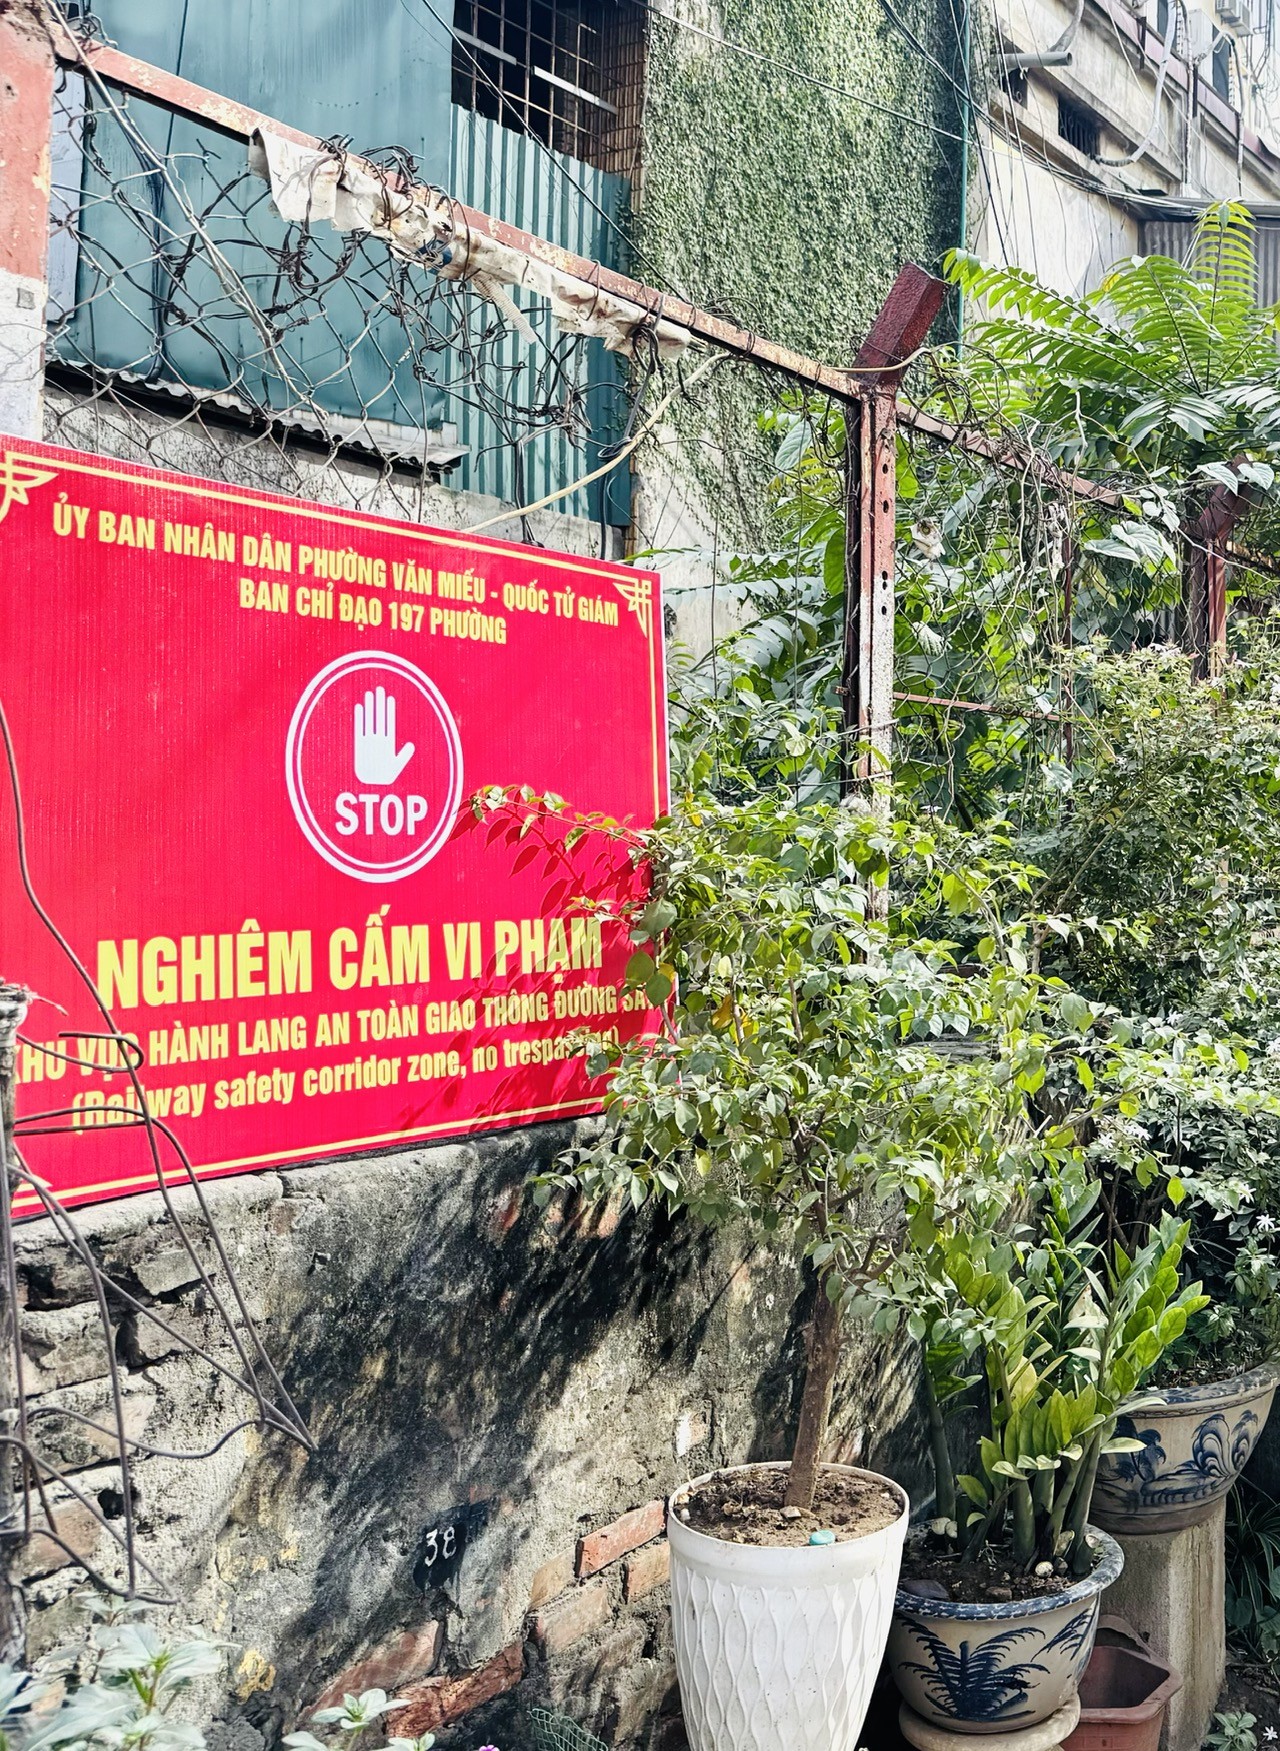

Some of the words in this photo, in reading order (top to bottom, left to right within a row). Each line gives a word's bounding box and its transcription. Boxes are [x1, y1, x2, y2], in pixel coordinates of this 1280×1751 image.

[53, 492, 90, 539] ỦY
[98, 510, 156, 549] BAN
[163, 522, 236, 562] NHÂN
[242, 532, 292, 572] DÂN
[298, 545, 387, 588] PHƯỜNG
[391, 558, 433, 595] VĂN
[437, 568, 486, 604] MIẾU
[502, 579, 549, 615] QUỐC
[553, 585, 574, 619] TỬ
[577, 595, 619, 627] GIÁM
[239, 577, 289, 614] BAN
[295, 582, 334, 620] CHỈ
[339, 592, 383, 631] ĐẠO
[387, 602, 425, 633] 197
[429, 606, 507, 645] PHƯỜNG
[335, 791, 428, 836] STOP
[97, 918, 313, 1013] NGHIÊM
[328, 904, 431, 991] CẤM
[442, 921, 482, 983] VI
[494, 914, 603, 985] PHẠM
[76, 1031, 140, 1082] VỰC
[149, 1020, 229, 1067] HÀNH
[238, 1015, 307, 1057] LANG
[314, 1011, 350, 1048] AN
[357, 999, 419, 1043] TOÀN
[425, 998, 477, 1034] GIAO
[482, 988, 549, 1028] THÔNG
[554, 980, 618, 1020] ĐƯỜNG
[214, 1067, 296, 1109] safety
[303, 1055, 402, 1096] corridor
[406, 1052, 467, 1083] zone,
[472, 1046, 498, 1074] no
[424, 1526, 457, 1567] 38
